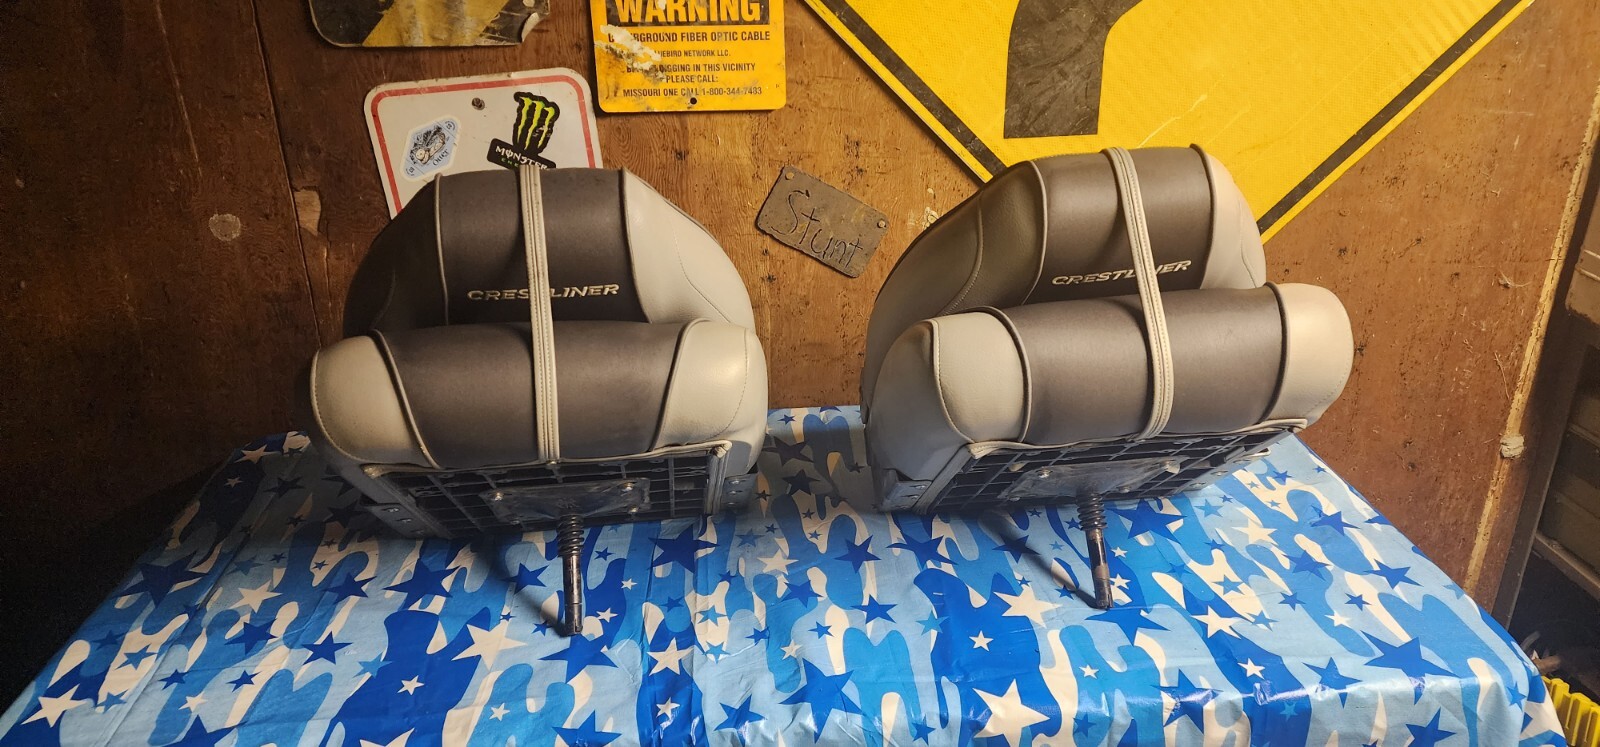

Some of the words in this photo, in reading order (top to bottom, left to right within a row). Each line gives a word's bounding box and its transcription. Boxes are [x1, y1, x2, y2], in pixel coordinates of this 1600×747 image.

[616, 0, 761, 23] WARNING
[608, 32, 678, 43] URGROUND
[681, 31, 708, 42] FIBER
[711, 31, 738, 42] OPTIC
[741, 31, 771, 41] CABLE
[684, 49, 715, 57] NETWORK
[693, 63, 701, 72] IN
[703, 63, 721, 72] THIS
[723, 62, 756, 72] VICINITY
[666, 74, 695, 83] PLEASE
[697, 74, 719, 83] CALL:
[623, 88, 661, 98] MISSOURI
[663, 88, 679, 97] ONE
[770, 189, 864, 268] Stunt
[466, 283, 620, 301] CRESLINER
